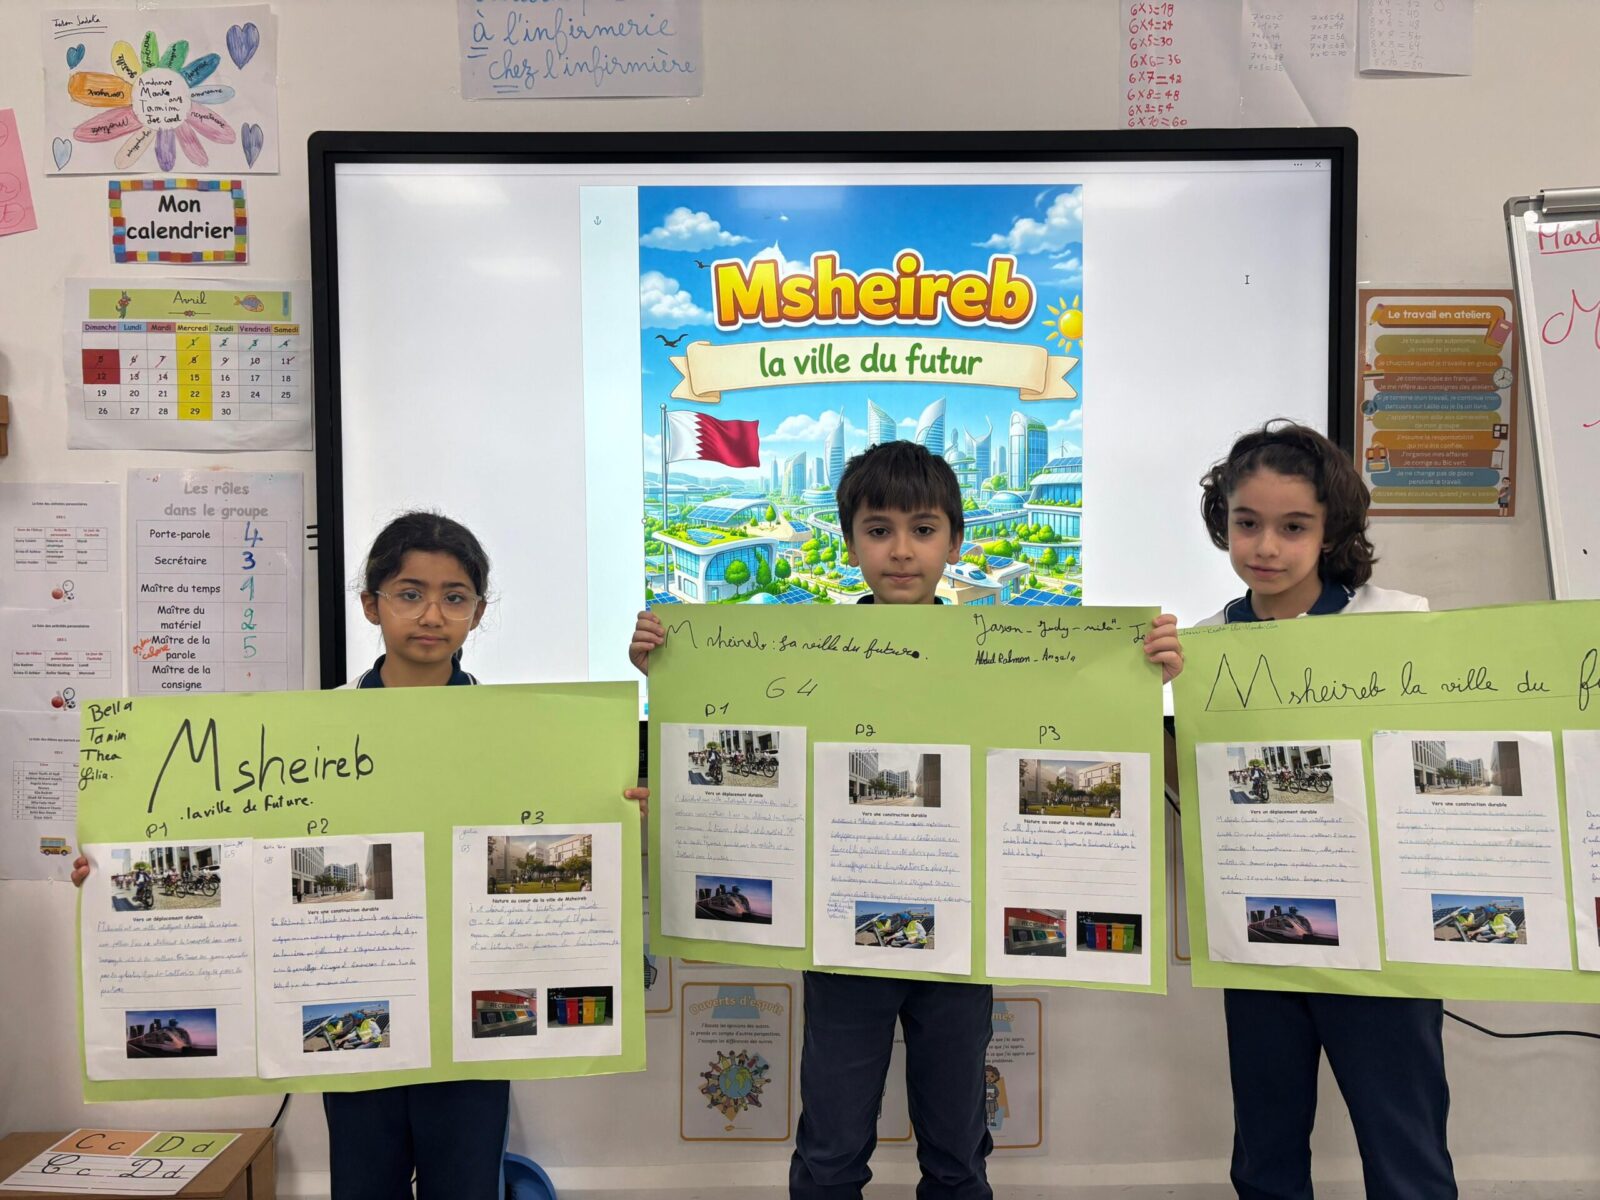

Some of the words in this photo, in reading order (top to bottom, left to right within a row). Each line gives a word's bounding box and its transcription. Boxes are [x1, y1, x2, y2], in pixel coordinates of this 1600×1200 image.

[473, 9, 494, 42] à
[503, 8, 676, 55] l'infirmerie
[489, 49, 539, 89] chez
[543, 46, 697, 87] l'infirmière
[158, 195, 201, 213] Mon
[126, 221, 234, 239] calendrier
[172, 290, 207, 305] Avril
[710, 248, 1037, 331] Msheireb
[1388, 310, 1400, 319] Le
[1403, 309, 1437, 319] travail
[1455, 310, 1491, 319] ateliers
[84, 323, 117, 331] Dimanche
[123, 323, 142, 331] Lundi
[151, 324, 172, 332] Mardi
[177, 324, 208, 332] Mercredi
[214, 324, 234, 333] Jeudi
[239, 325, 271, 333] Vendredi
[759, 346, 785, 379] la
[793, 344, 851, 374] ville
[859, 343, 896, 373] du
[905, 343, 982, 376] futur
[220, 374, 230, 382] 16
[250, 374, 261, 382] 17
[281, 374, 291, 382] 18
[97, 389, 107, 397] 19
[158, 390, 168, 398] 21
[190, 390, 200, 398] 22
[220, 390, 230, 398] 23
[250, 391, 261, 399] 24
[281, 391, 291, 399] 25
[98, 407, 108, 415] 26
[130, 407, 140, 415] 27
[158, 407, 168, 415] 28
[190, 407, 200, 415] 29
[221, 408, 231, 416] 30
[184, 483, 209, 495] Les
[214, 482, 250, 495] rôles
[164, 504, 196, 516] dans
[203, 504, 216, 516] le
[221, 507, 269, 520] groupe
[150, 529, 211, 540] Porte-parole
[244, 521, 263, 548] 4
[154, 556, 207, 565] Secrétaire
[241, 551, 256, 570] 3
[140, 584, 174, 593] Maître
[177, 584, 189, 593] du
[192, 586, 221, 595] temps
[240, 575, 255, 601] 1
[157, 605, 190, 615] Maître
[193, 606, 205, 615] du
[160, 620, 201, 630] matériel
[240, 608, 257, 630] 2
[151, 635, 185, 645] Maître
[187, 636, 199, 645] de
[202, 636, 210, 645] la
[243, 635, 257, 658] 5
[165, 651, 196, 661] parole
[151, 665, 185, 674] Maître
[187, 665, 200, 674] de
[203, 665, 211, 674] la
[1401, 661, 1427, 694] la
[1441, 667, 1499, 692] ville
[1517, 666, 1551, 694] du
[161, 681, 202, 690] consigne
[88, 701, 133, 722] Bella
[80, 749, 122, 761] Thea
[147, 718, 374, 814] Msheireb
[307, 818, 328, 834] P2
[75, 1133, 106, 1149] C
[108, 1141, 125, 1151] c
[154, 1136, 184, 1153] D
[192, 1140, 215, 1153] d
[41, 1155, 81, 1174] C
[76, 1167, 91, 1176] c
[118, 1158, 163, 1178] D
[162, 1165, 186, 1178] d
